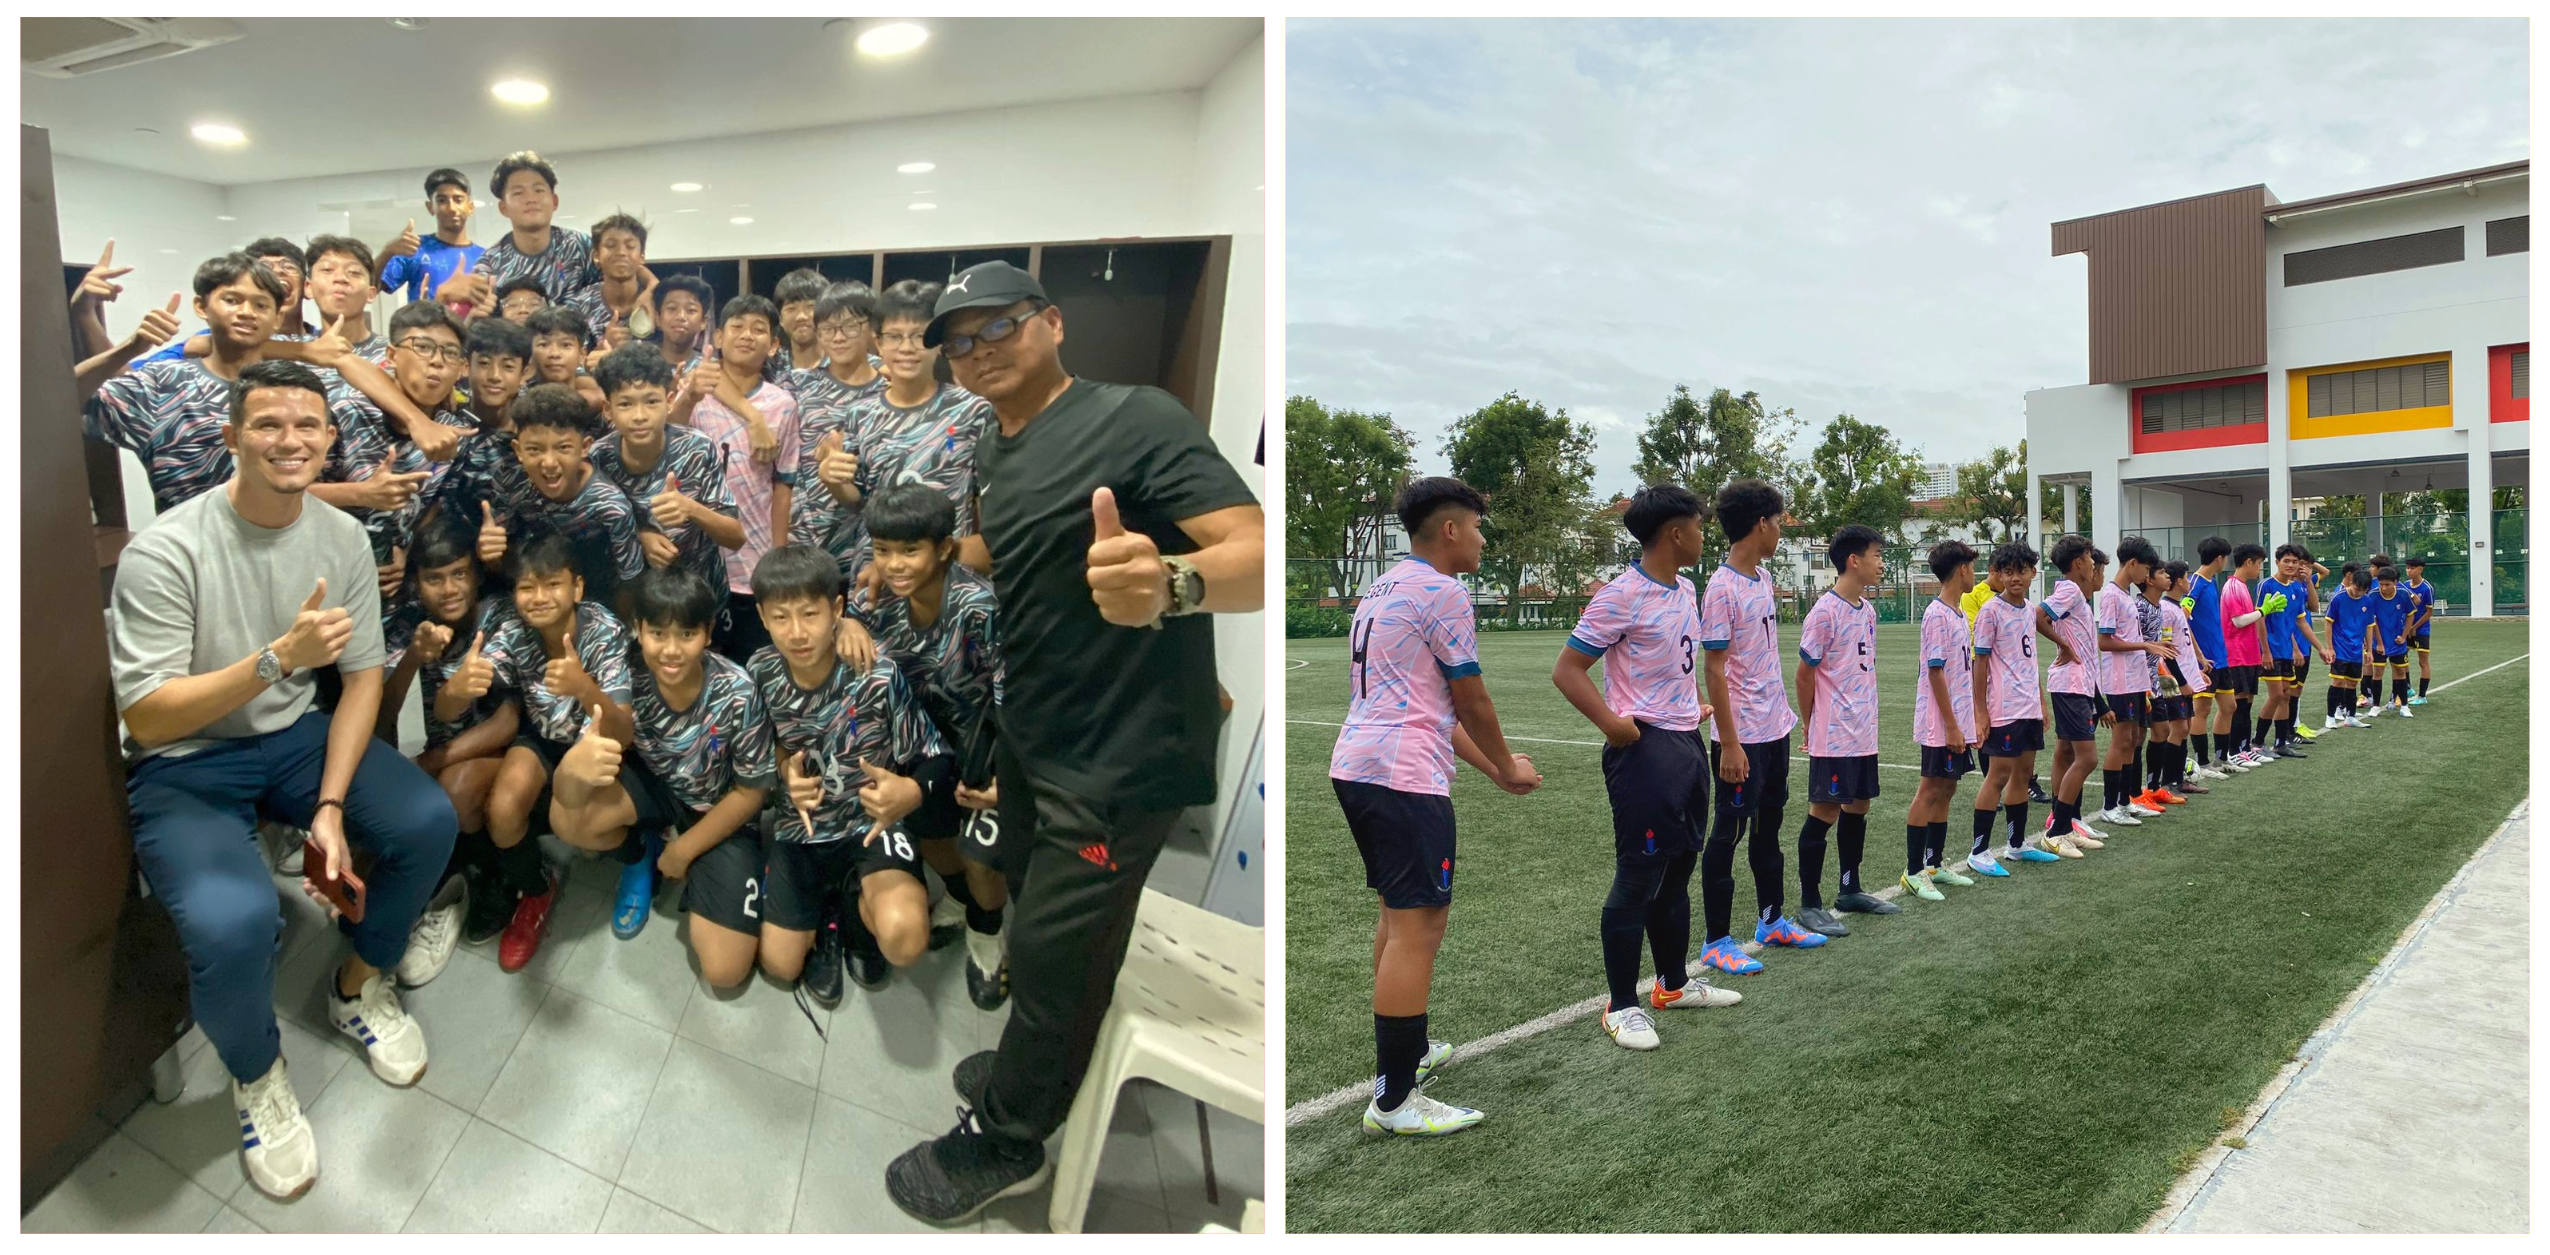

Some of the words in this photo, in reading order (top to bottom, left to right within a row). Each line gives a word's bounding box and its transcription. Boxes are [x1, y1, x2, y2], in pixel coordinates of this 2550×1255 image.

[1363, 581, 1400, 600] EGENT
[1352, 617, 1375, 699] 4
[1680, 634, 1694, 675] 3
[2021, 634, 2032, 658] 6
[879, 829, 914, 862] 18
[965, 808, 999, 847] 15
[743, 877, 759, 918] 2
